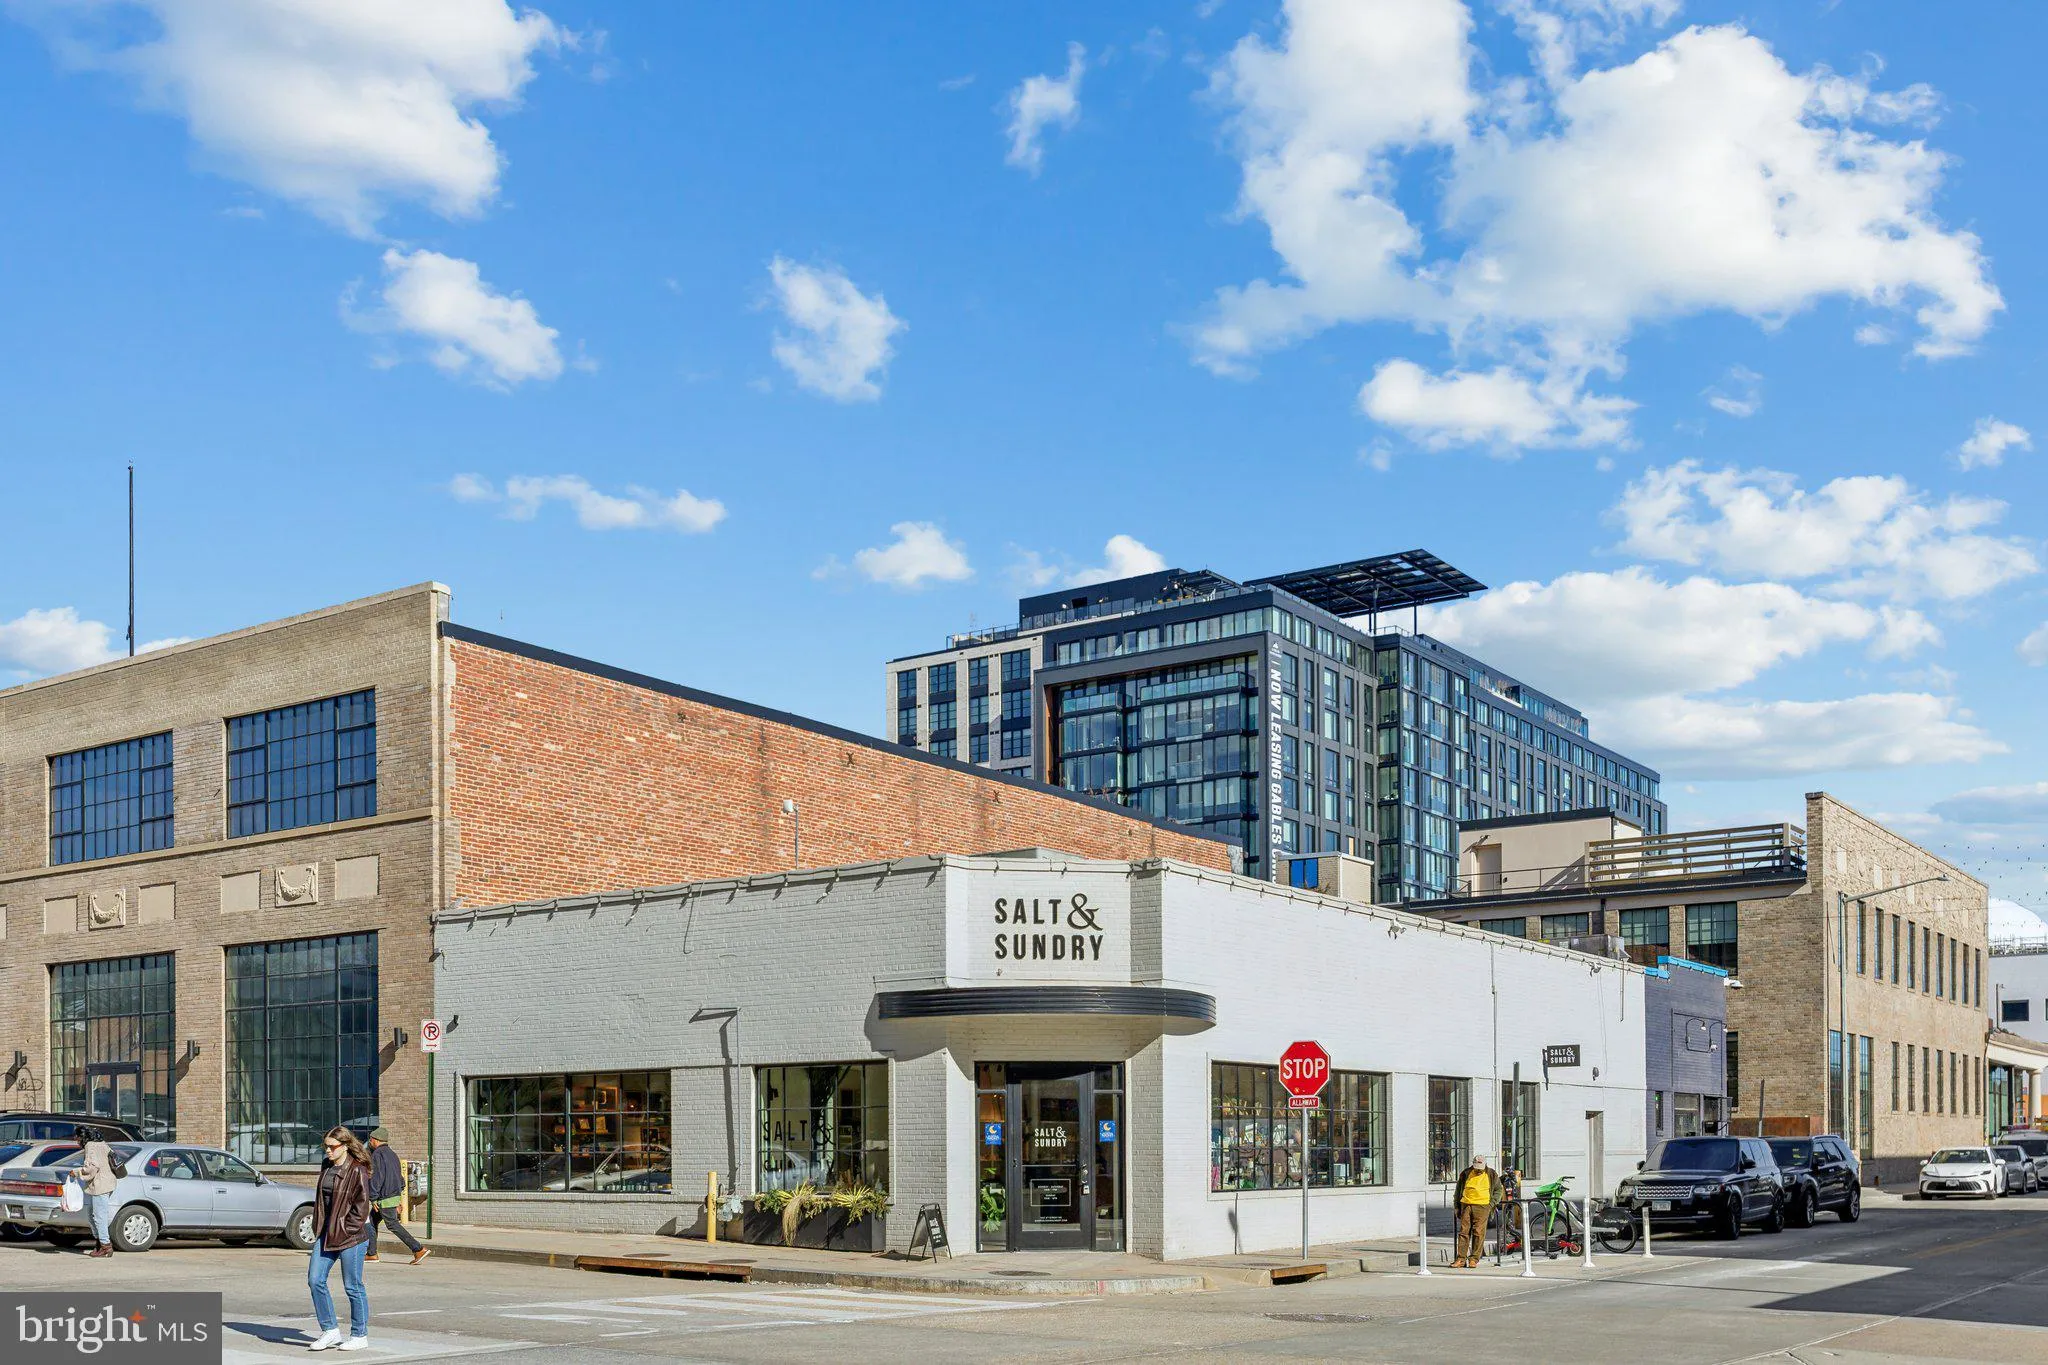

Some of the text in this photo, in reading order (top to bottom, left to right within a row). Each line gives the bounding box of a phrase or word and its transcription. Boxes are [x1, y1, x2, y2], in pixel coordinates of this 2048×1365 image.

[1271, 669, 1282, 711] NOW
[1271, 712, 1282, 780] LEASING
[1271, 783, 1282, 845] GABLES
[994, 933, 1104, 961] SUNDRY
[1282, 1057, 1326, 1080] STOP
[1550, 1056, 1576, 1064] SUNDRY
[1034, 1138, 1067, 1147] SUNDRY
